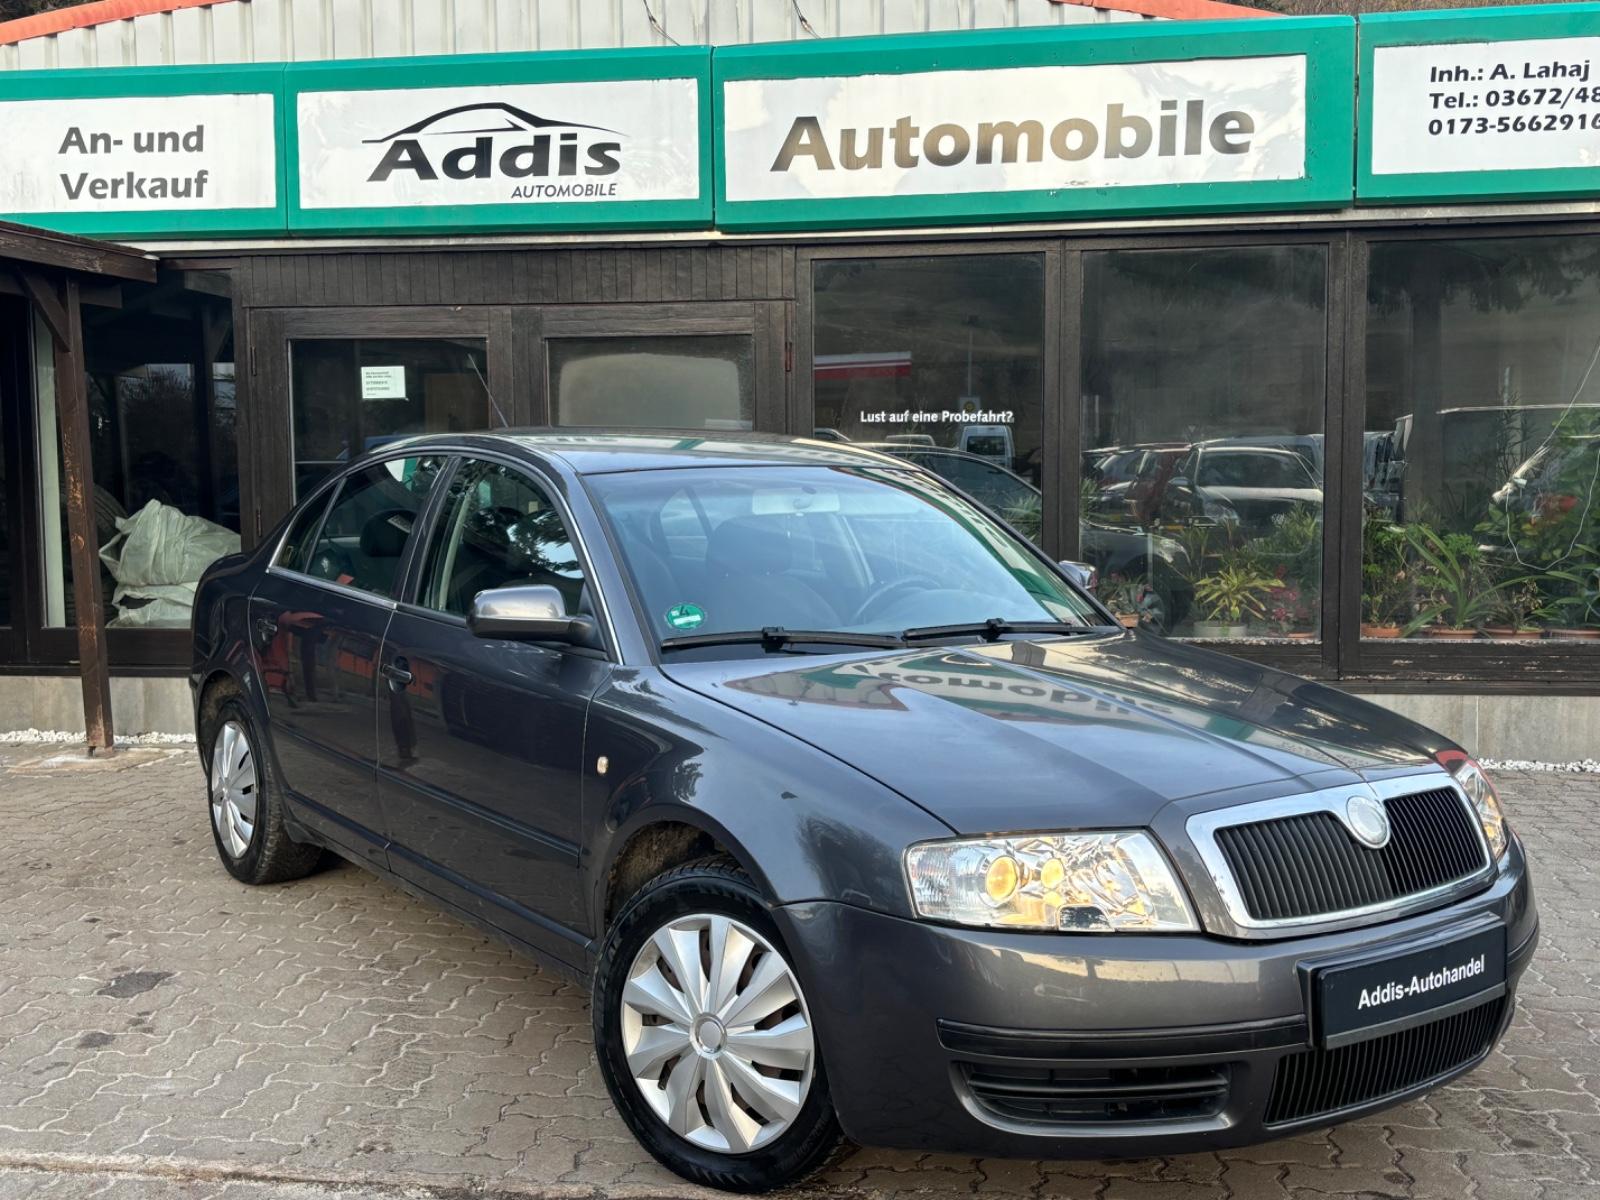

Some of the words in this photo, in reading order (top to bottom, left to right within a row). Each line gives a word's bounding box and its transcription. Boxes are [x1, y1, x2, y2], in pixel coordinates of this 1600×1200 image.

[1430, 65, 1484, 83] Inh.:
[1489, 63, 1516, 81] A.
[1523, 59, 1590, 82] Lahaj
[1429, 91, 1479, 109] Tel.:
[58, 126, 123, 155] An-
[135, 124, 204, 153] und
[770, 99, 1255, 172] Automobile
[367, 133, 622, 183] Addis
[59, 169, 209, 200] Verkauf
[510, 182, 618, 199] AUTOMOBILE
[860, 409, 886, 423] Lust
[889, 410, 911, 423] auf
[912, 410, 938, 423] eine
[941, 409, 1014, 423] Probefahrt?
[1358, 954, 1485, 1010] Addis-Autohandel
